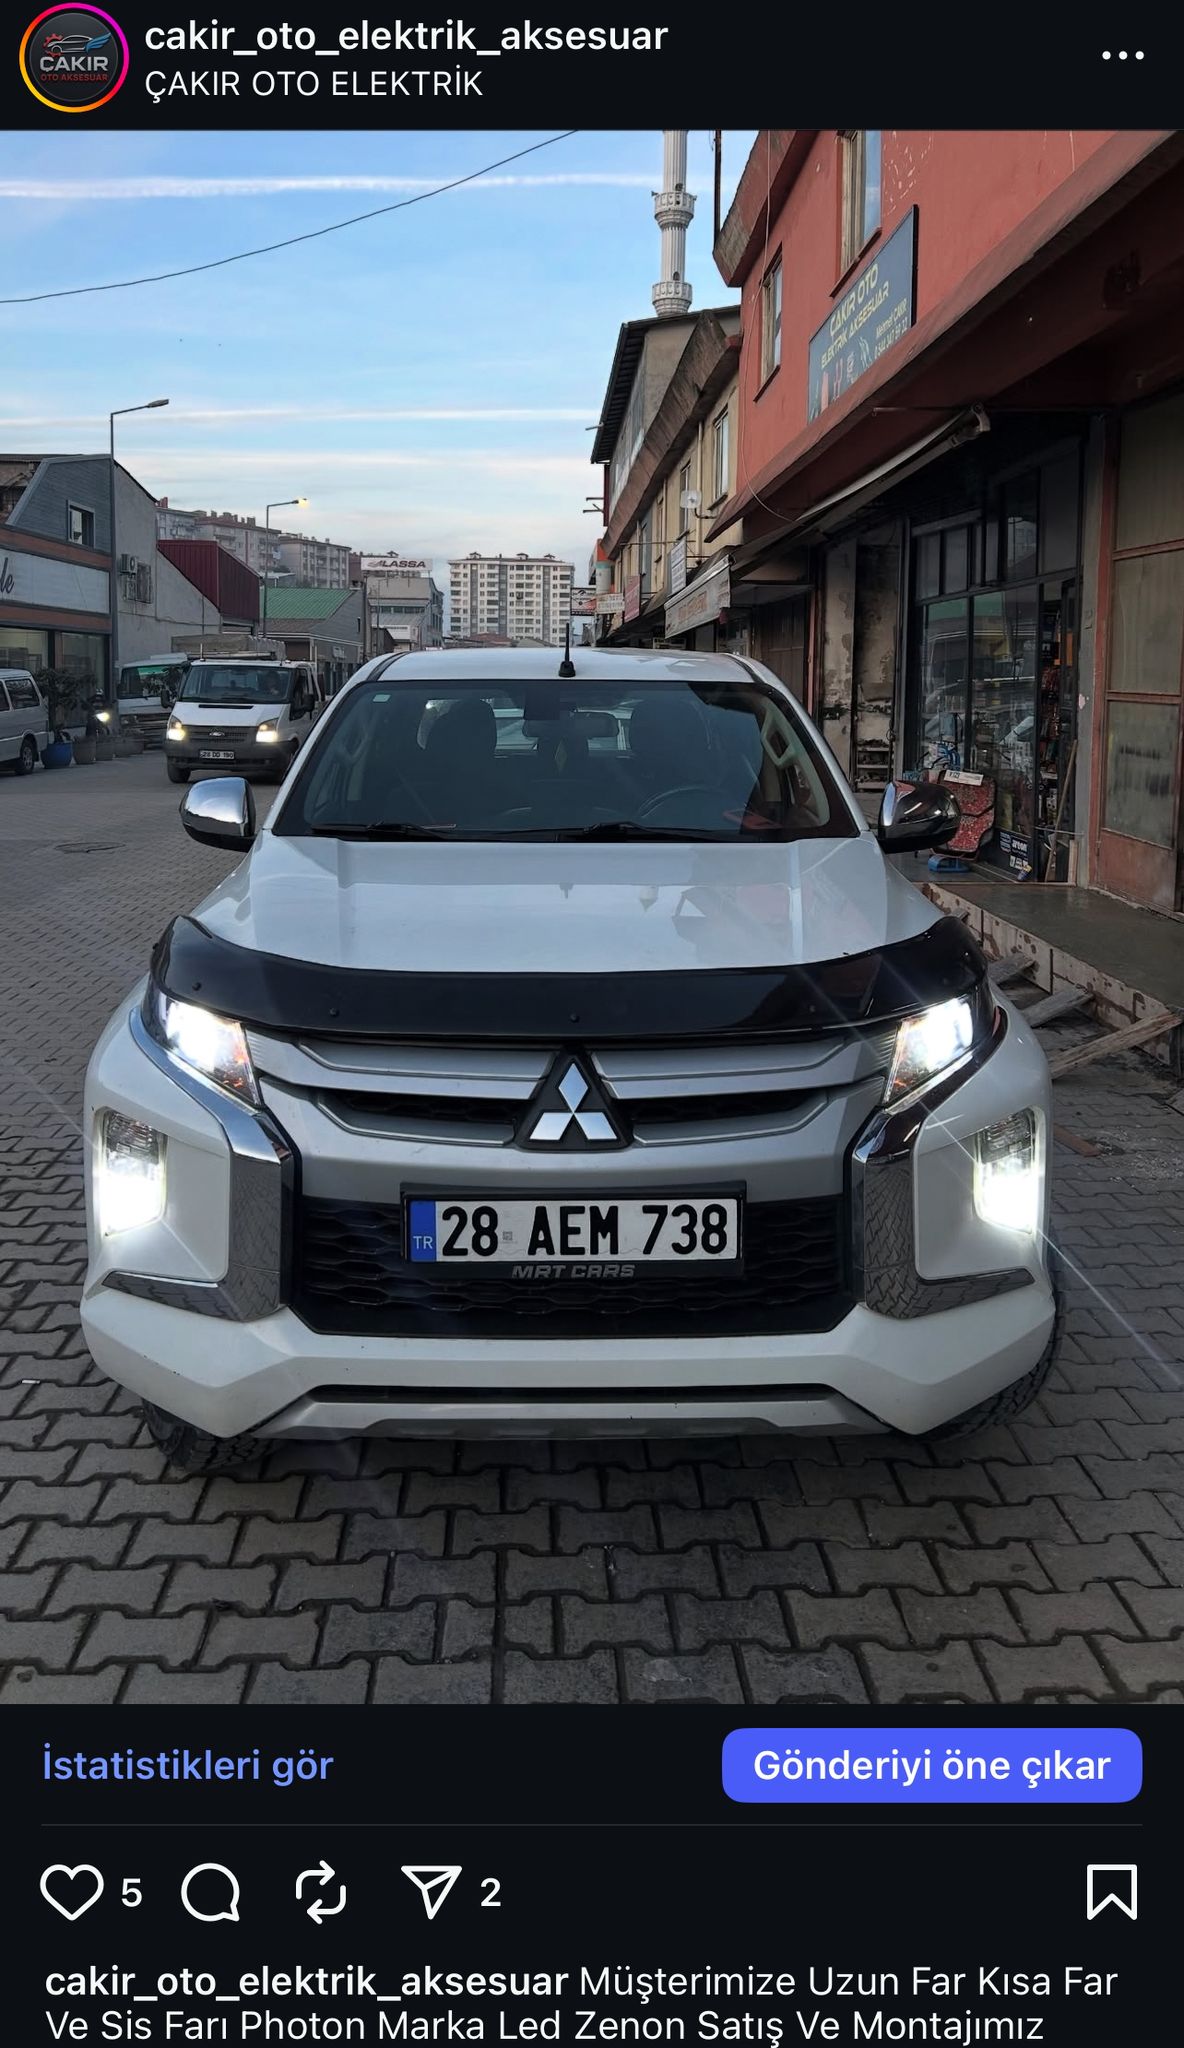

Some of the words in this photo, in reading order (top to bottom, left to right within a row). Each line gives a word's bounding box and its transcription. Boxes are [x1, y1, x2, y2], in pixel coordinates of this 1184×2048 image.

[858, 263, 878, 304] OTO
[849, 281, 889, 338] AKSESUAR
[382, 560, 426, 568] LASSA
[413, 1236, 433, 1250] TR
[442, 1205, 498, 1257] 28
[528, 1205, 619, 1256] AEM
[642, 1204, 728, 1255] 738
[511, 1264, 566, 1279] MRT
[571, 1264, 636, 1279] CARS
